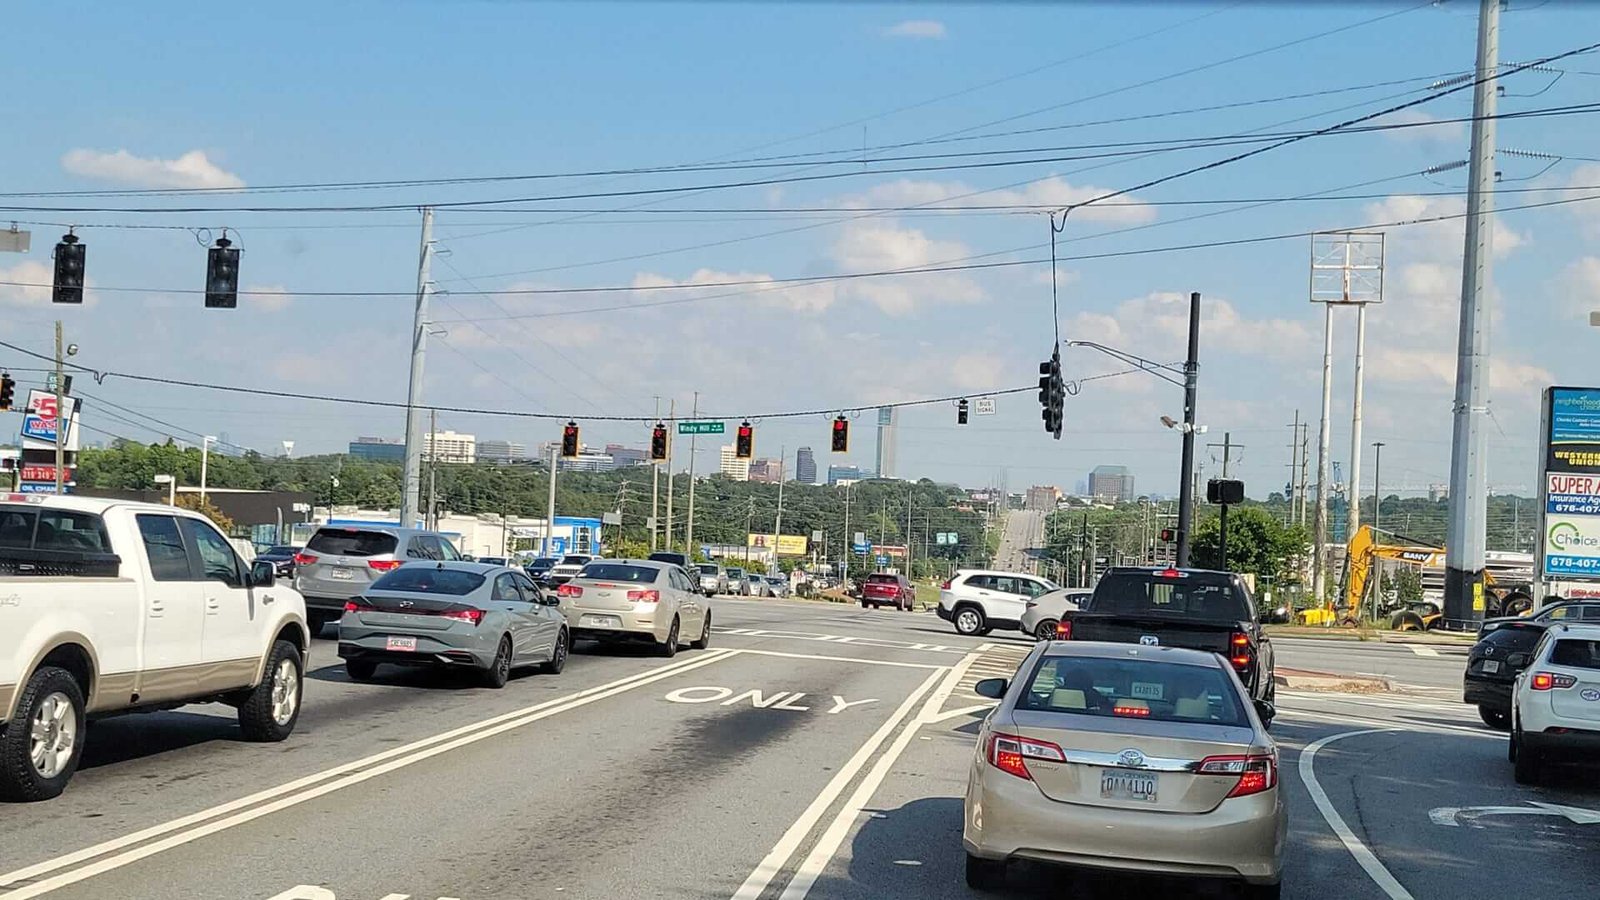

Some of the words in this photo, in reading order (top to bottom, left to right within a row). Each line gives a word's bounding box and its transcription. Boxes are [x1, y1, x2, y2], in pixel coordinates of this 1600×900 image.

[680, 425, 697, 433] Windy
[1551, 477, 1593, 494] SUPER
[1550, 494, 1587, 503] Insurance
[1556, 534, 1598, 546] Choice
[665, 686, 880, 713] ONLY
